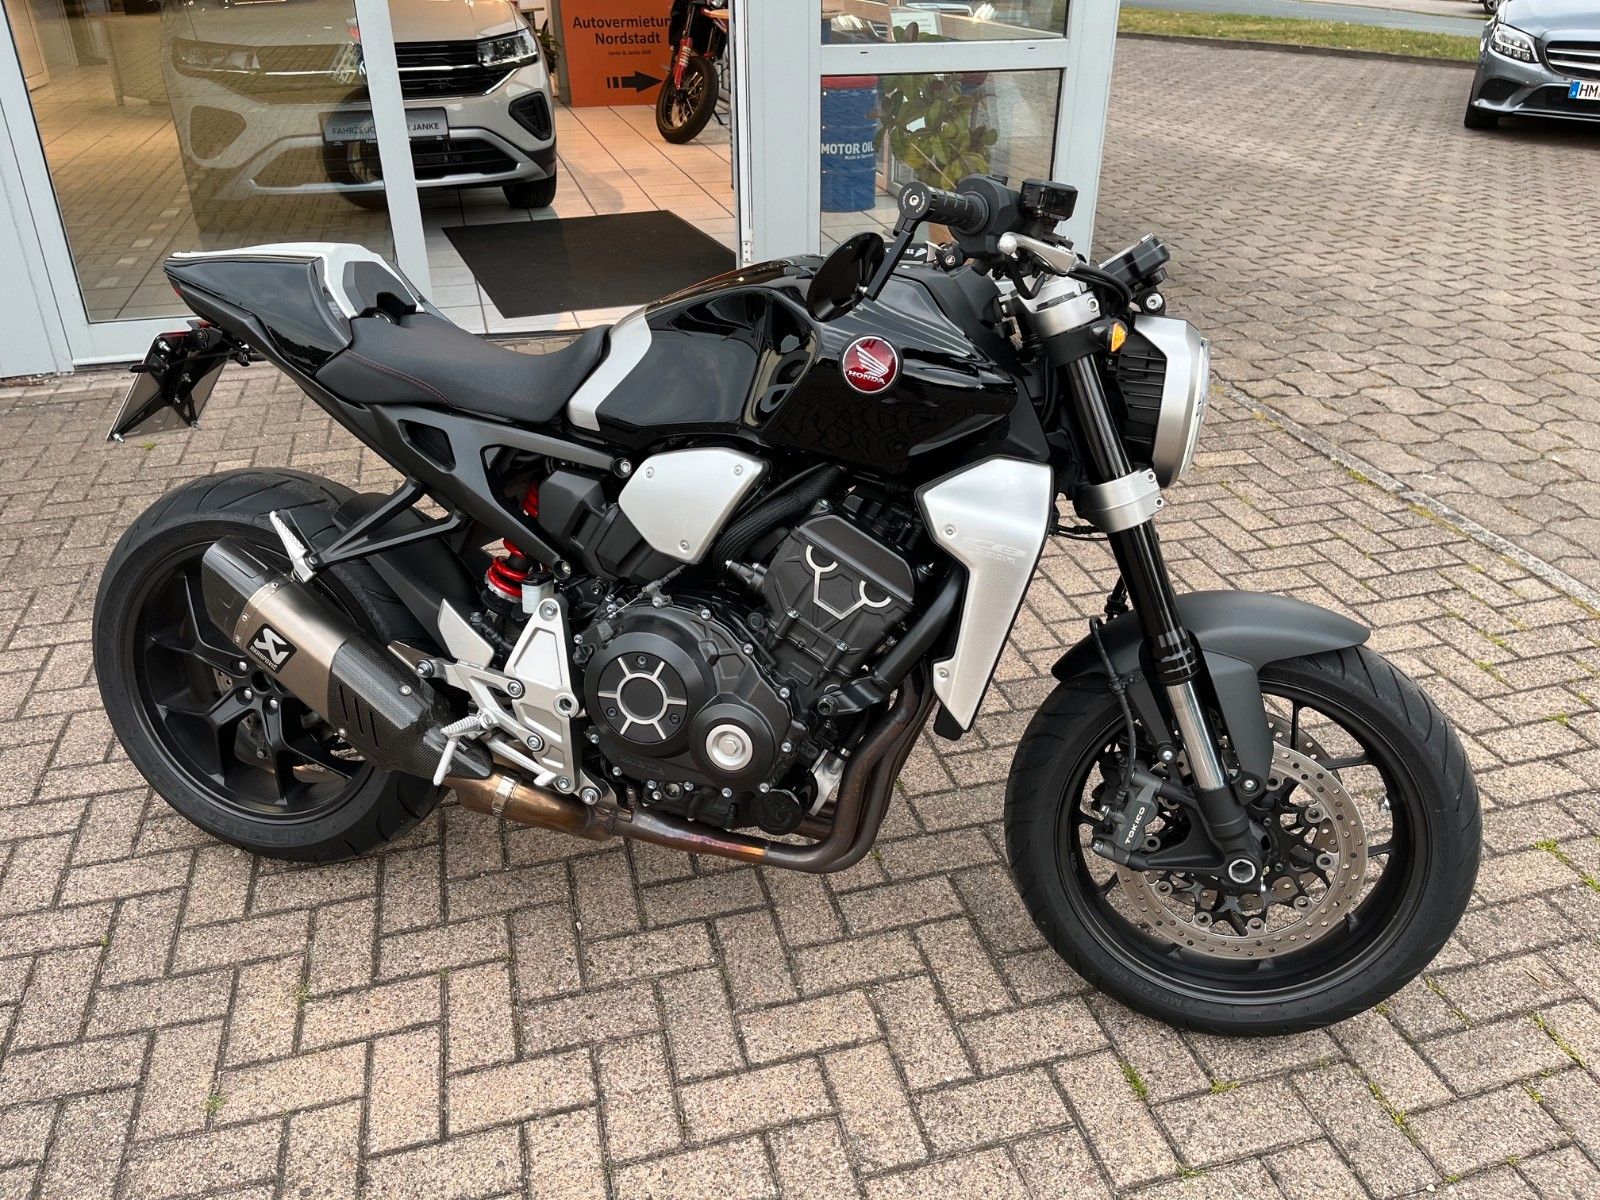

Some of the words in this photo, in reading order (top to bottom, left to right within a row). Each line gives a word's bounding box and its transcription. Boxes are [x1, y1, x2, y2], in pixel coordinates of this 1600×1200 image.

[573, 15, 671, 28] Autovermietun
[595, 32, 661, 44] Nordstadt
[1579, 84, 1599, 97] HM
[412, 122, 440, 131] JANKE
[821, 143, 860, 154] MOTOR
[862, 141, 874, 153] OIL
[848, 370, 885, 384] HONDA
[1125, 807, 1146, 844] TOKICO
